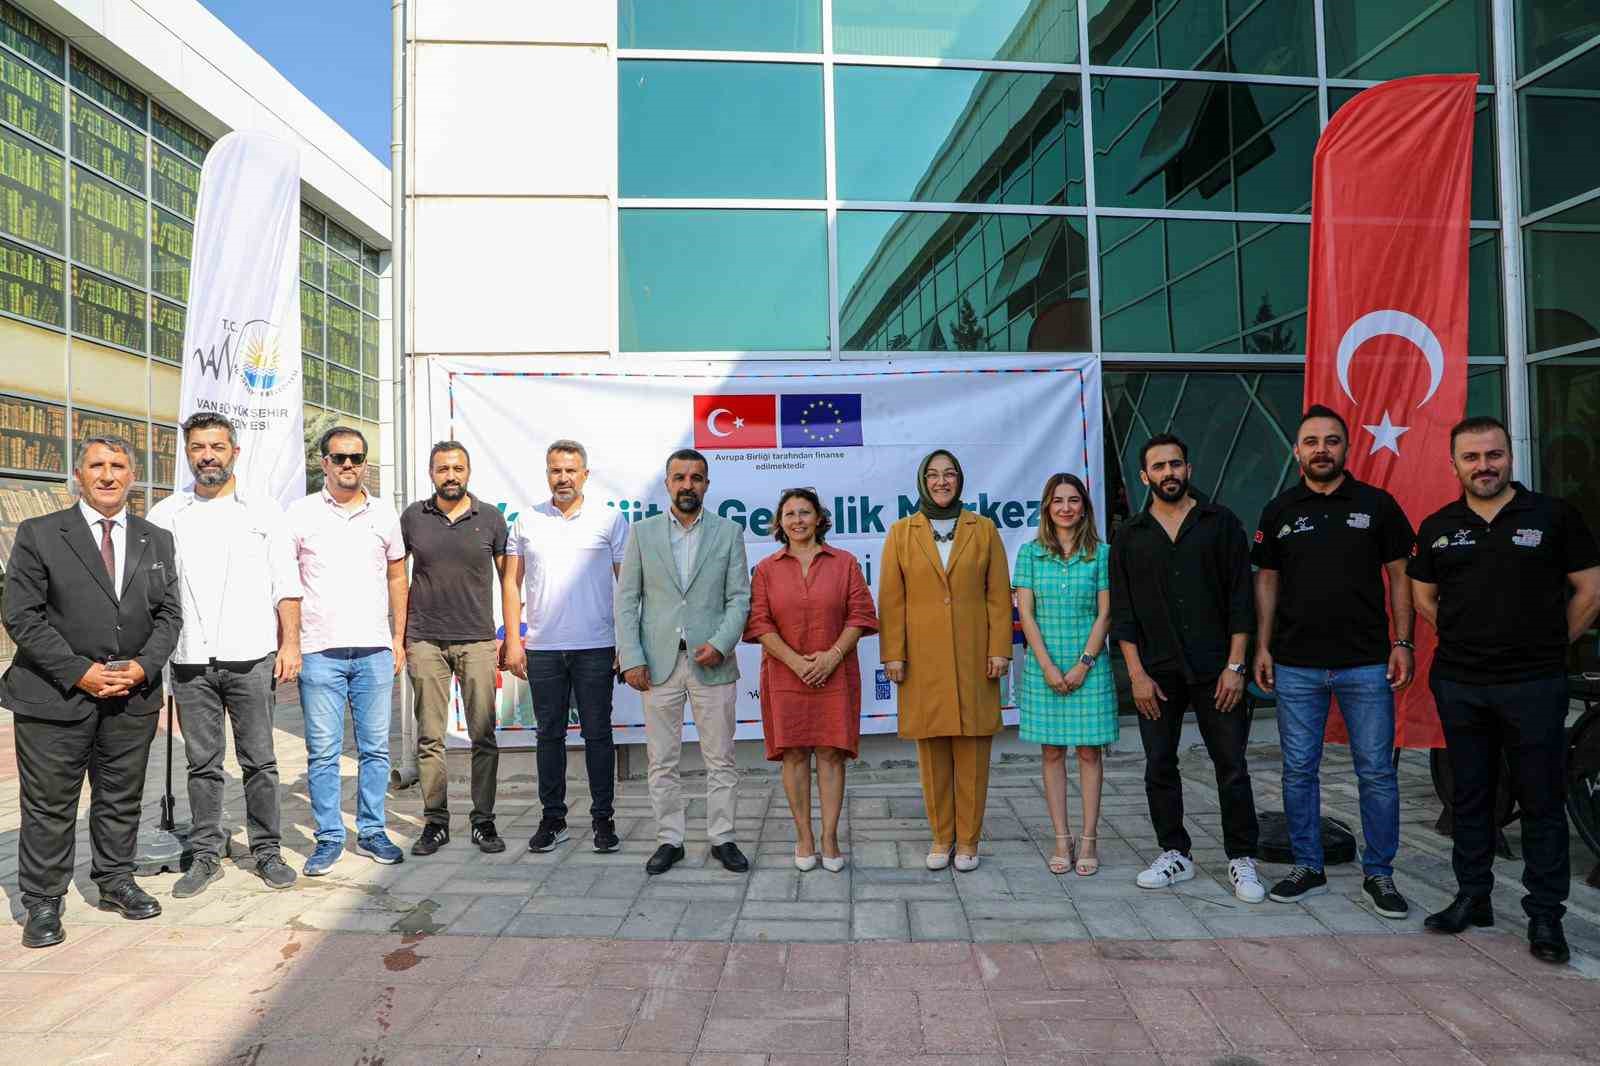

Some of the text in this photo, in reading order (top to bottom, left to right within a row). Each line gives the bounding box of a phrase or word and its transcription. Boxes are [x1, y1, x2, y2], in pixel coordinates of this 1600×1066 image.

[196, 398, 218, 411] VAN
[715, 453, 743, 462] Avrupa
[815, 450, 845, 460] finanse
[755, 462, 805, 471] edilmektedir
[718, 496, 886, 537] Gelik
